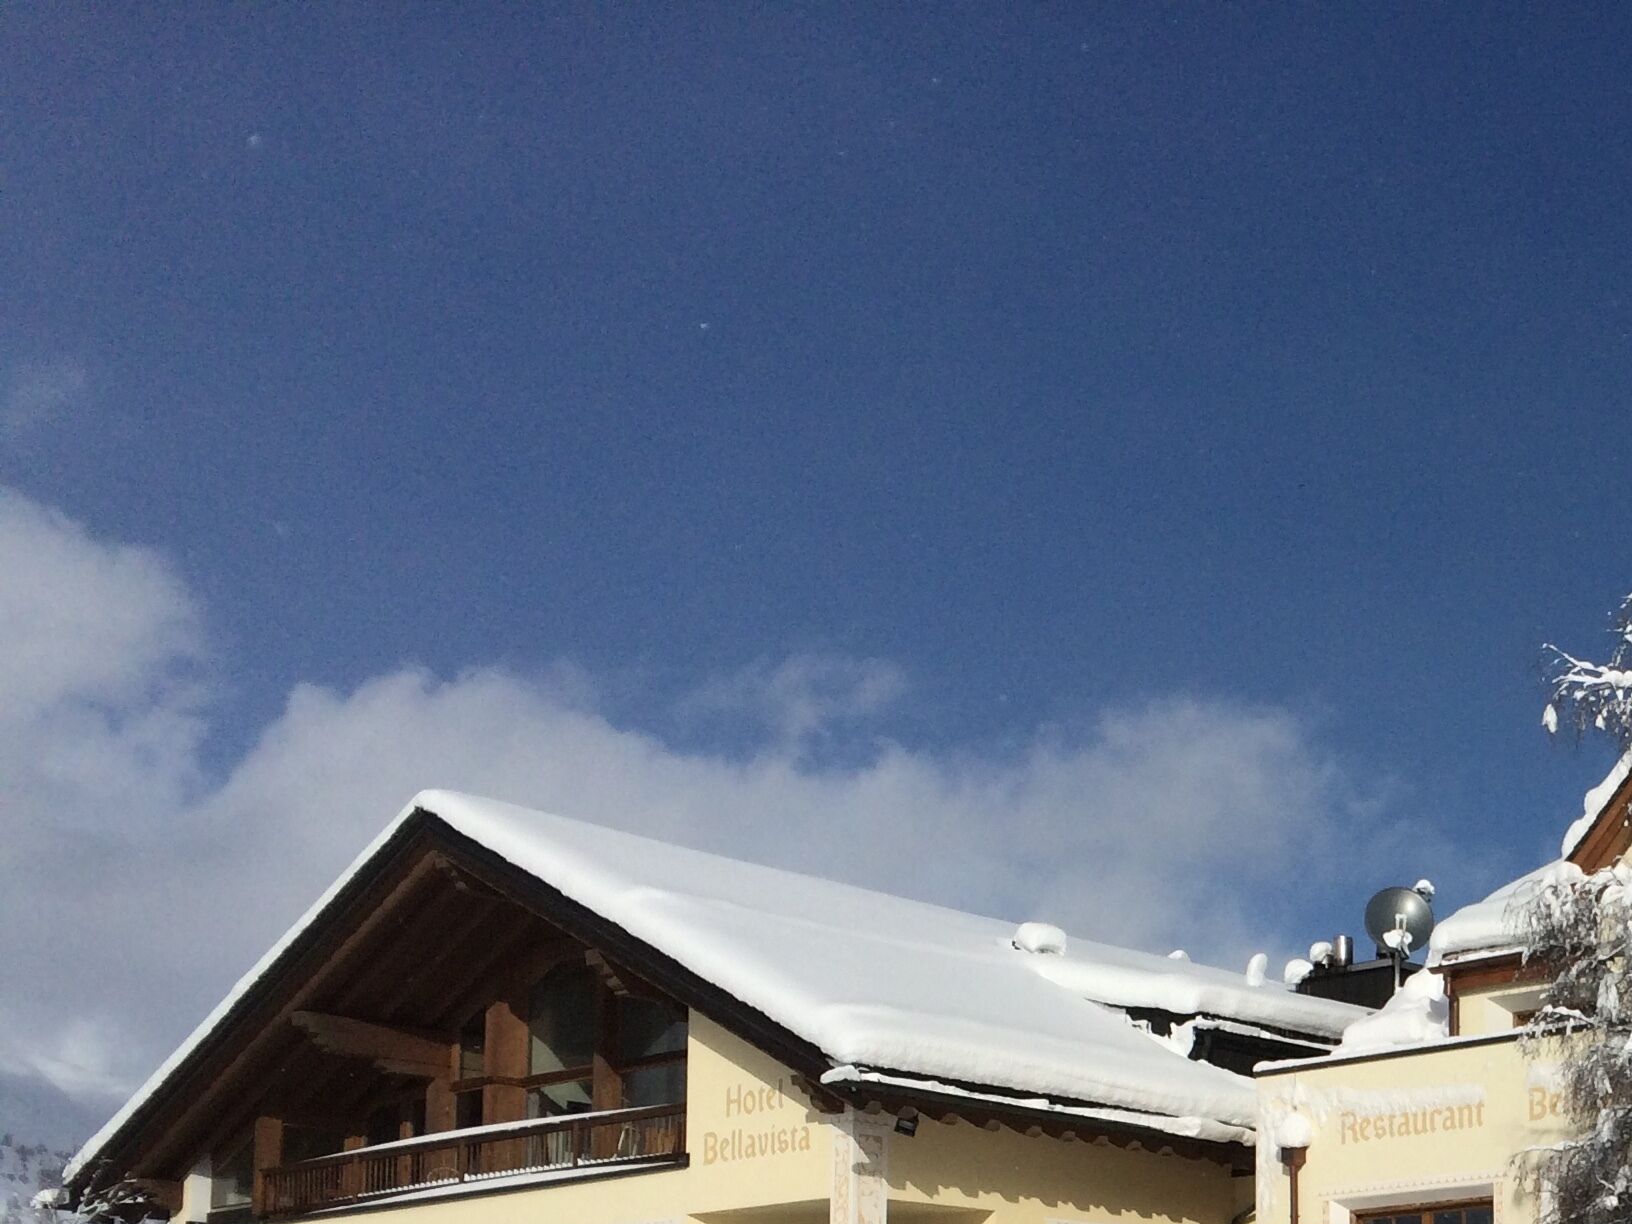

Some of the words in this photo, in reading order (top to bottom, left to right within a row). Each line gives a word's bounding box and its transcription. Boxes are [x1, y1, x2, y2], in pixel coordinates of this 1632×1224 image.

[725, 1078, 785, 1118] Hotel
[1340, 1100, 1486, 1145] Restaurant
[702, 1124, 812, 1166] Bellavista
